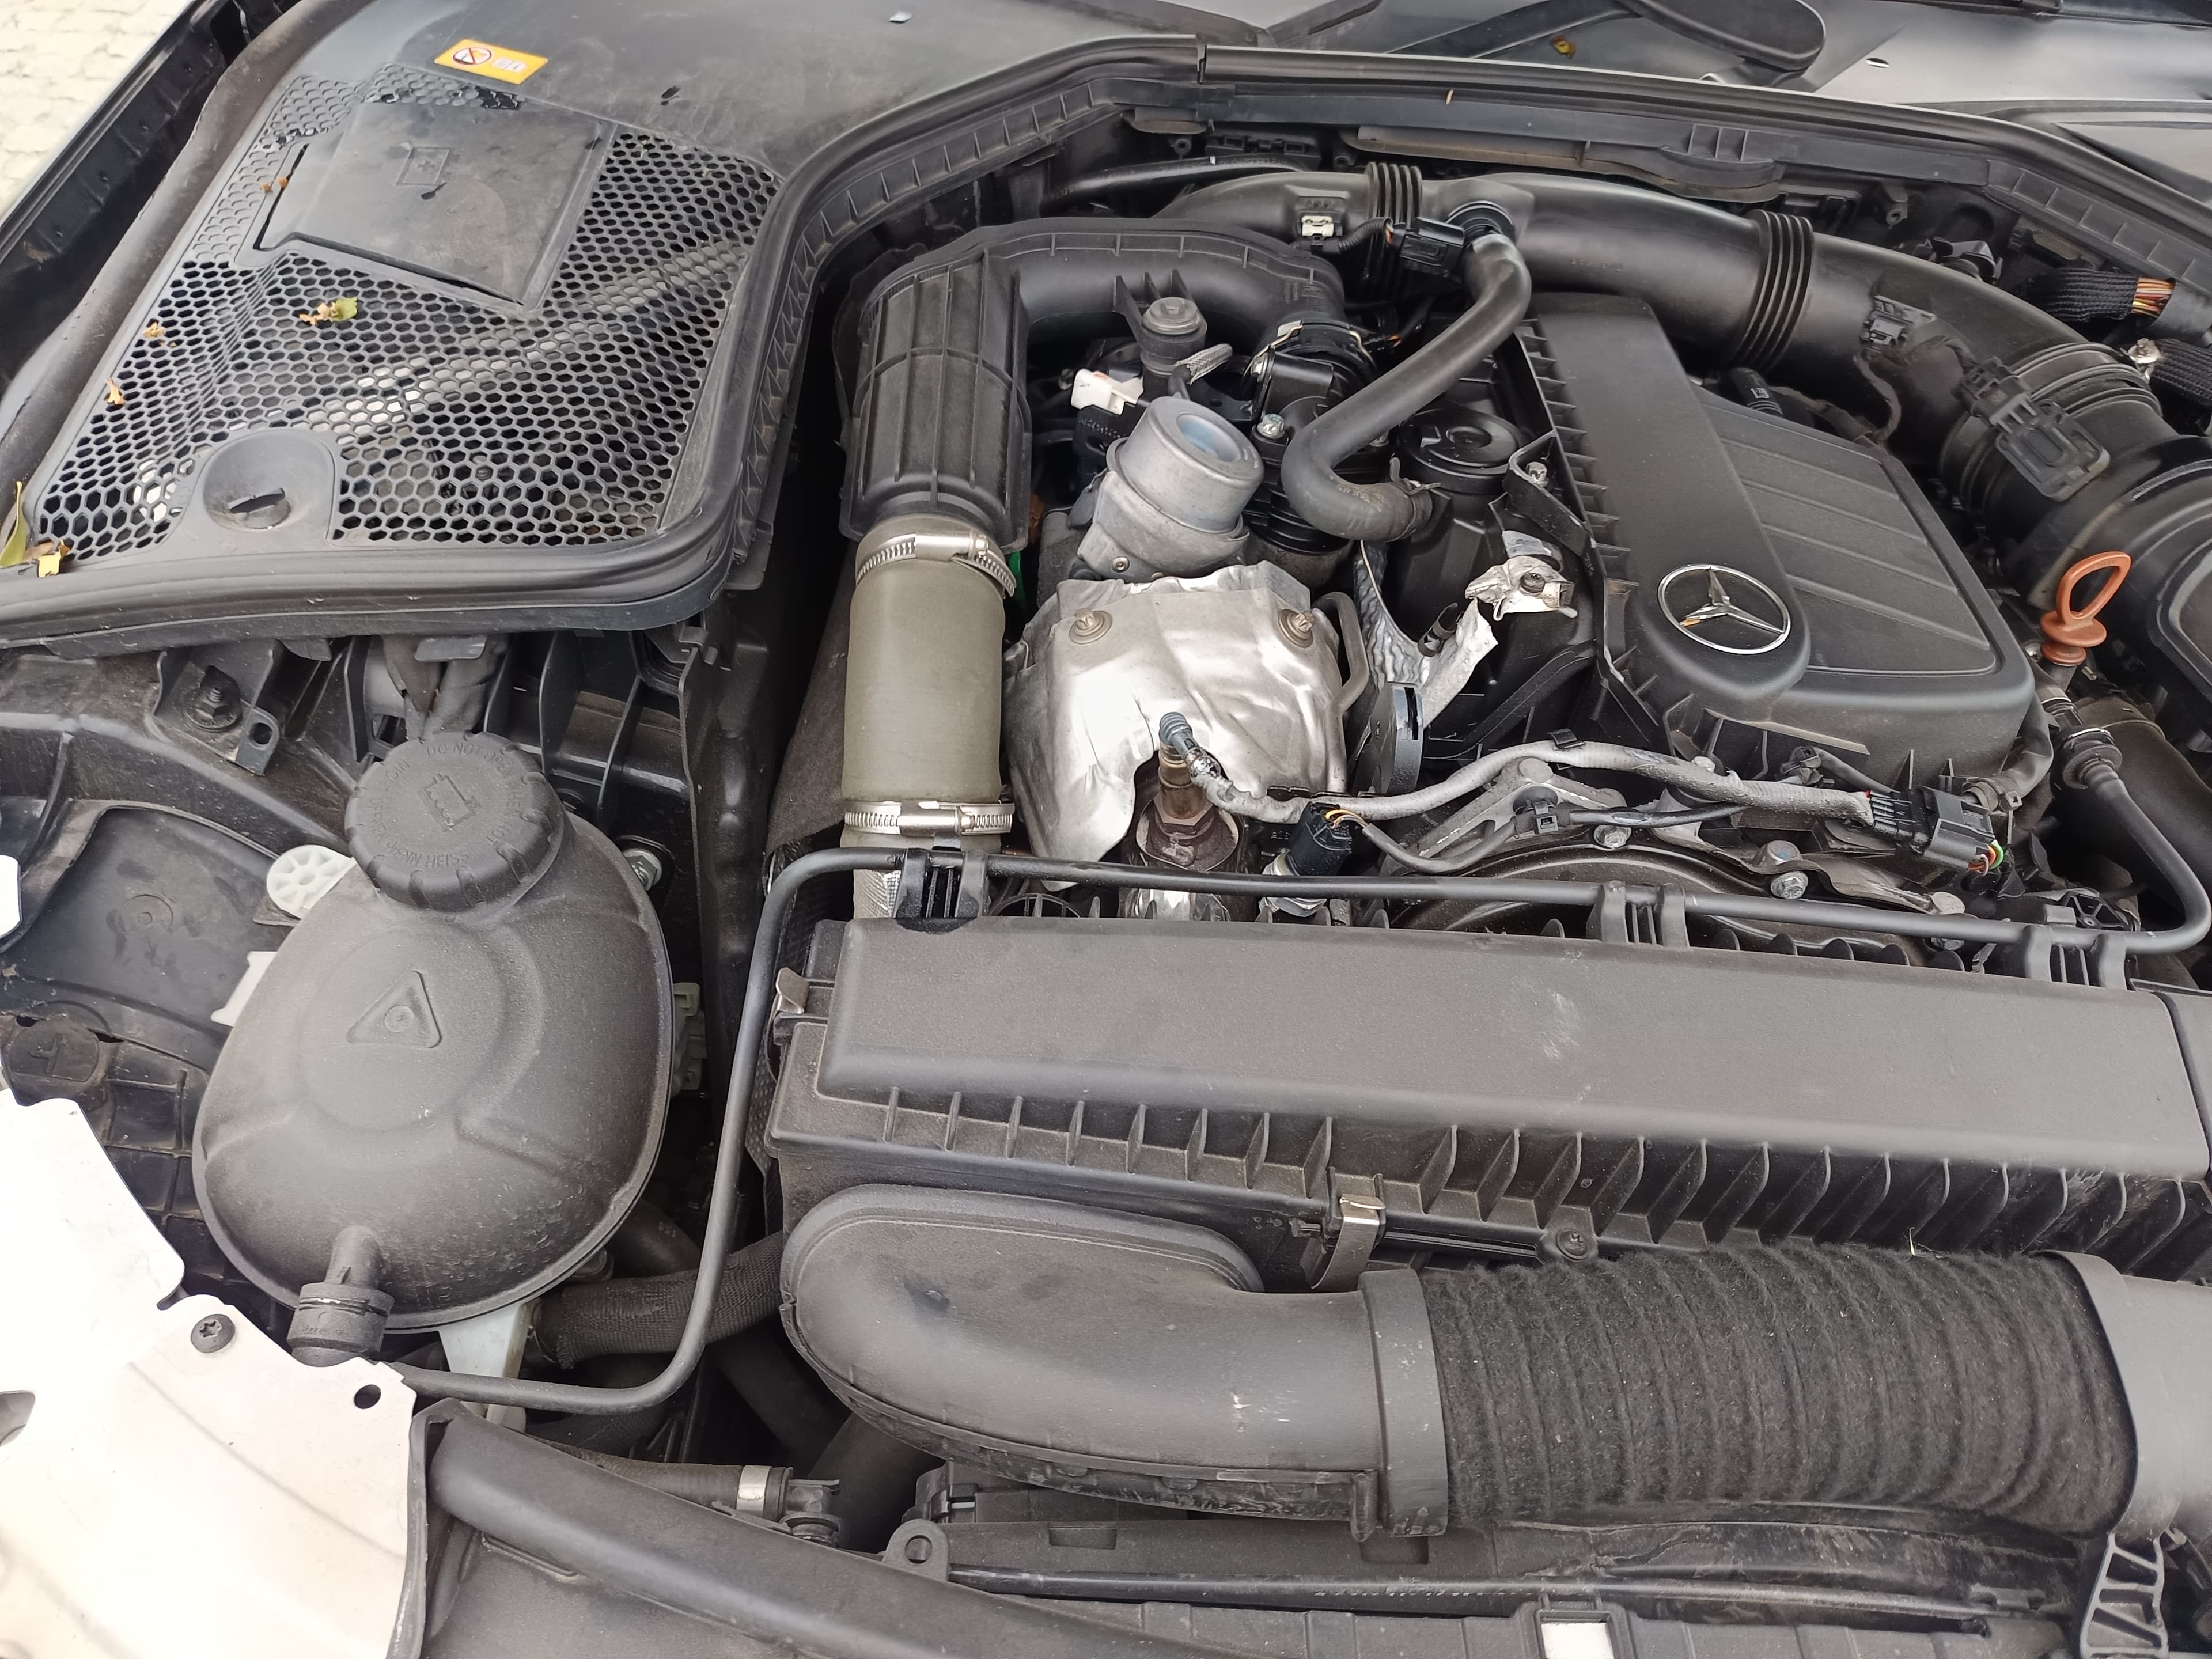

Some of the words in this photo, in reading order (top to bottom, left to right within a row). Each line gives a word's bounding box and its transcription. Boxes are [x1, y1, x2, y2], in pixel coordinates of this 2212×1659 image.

[427, 745, 447, 756] DO
[453, 742, 484, 756] NOT
[486, 818, 513, 846] HOT
[386, 840, 422, 865] WENN
[425, 853, 469, 868] HEISS
